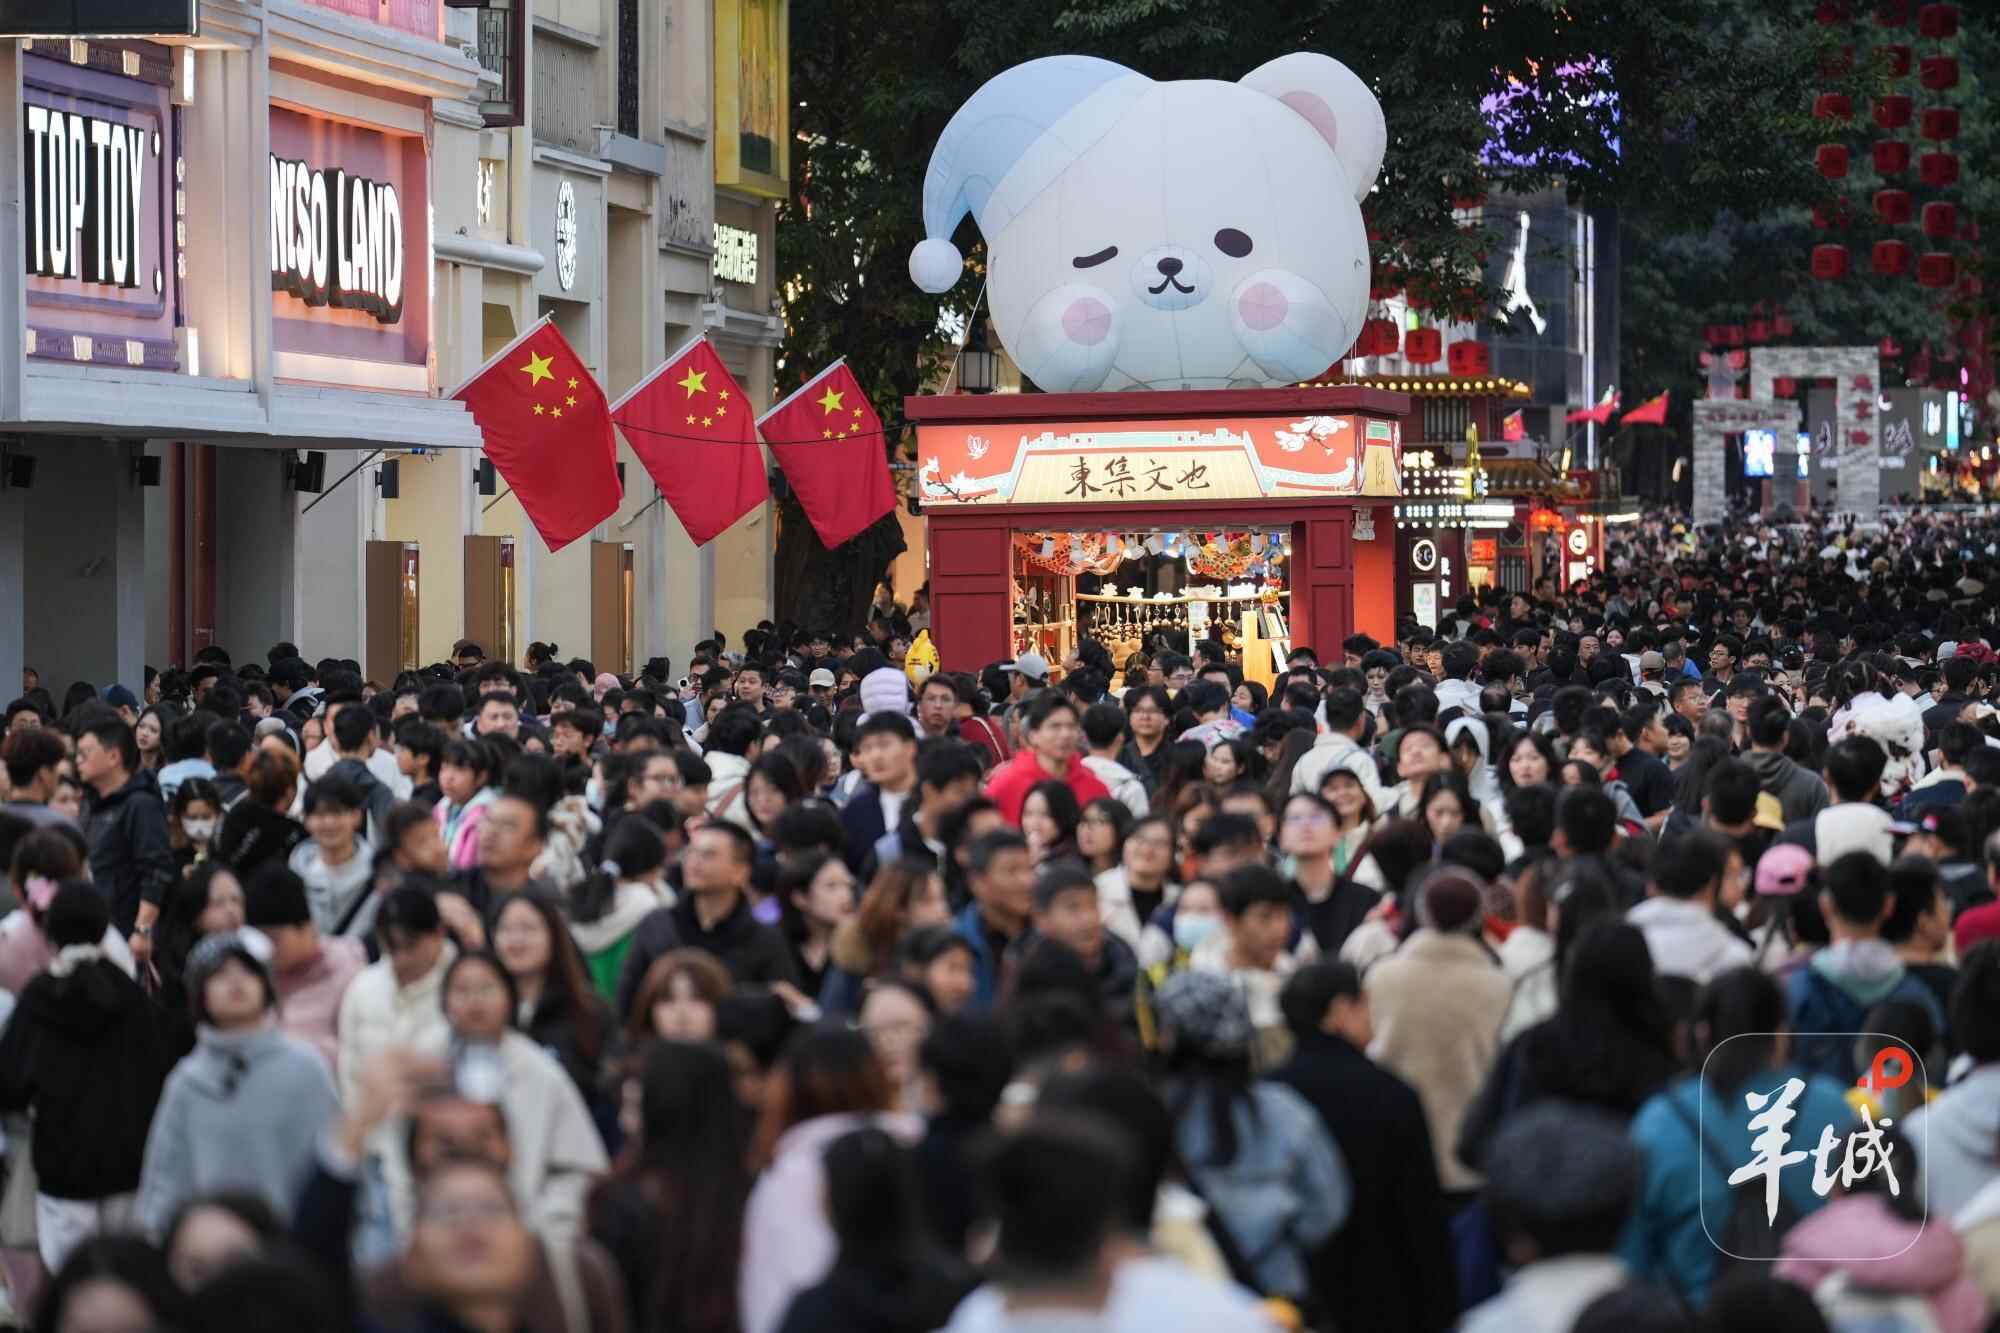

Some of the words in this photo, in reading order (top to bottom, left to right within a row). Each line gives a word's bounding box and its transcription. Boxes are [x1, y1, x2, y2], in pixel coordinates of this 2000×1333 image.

[28, 105, 86, 278] TOP
[92, 118, 145, 287] TOY
[337, 169, 402, 308] LAND
[1064, 455, 1211, 499] 東集文也
